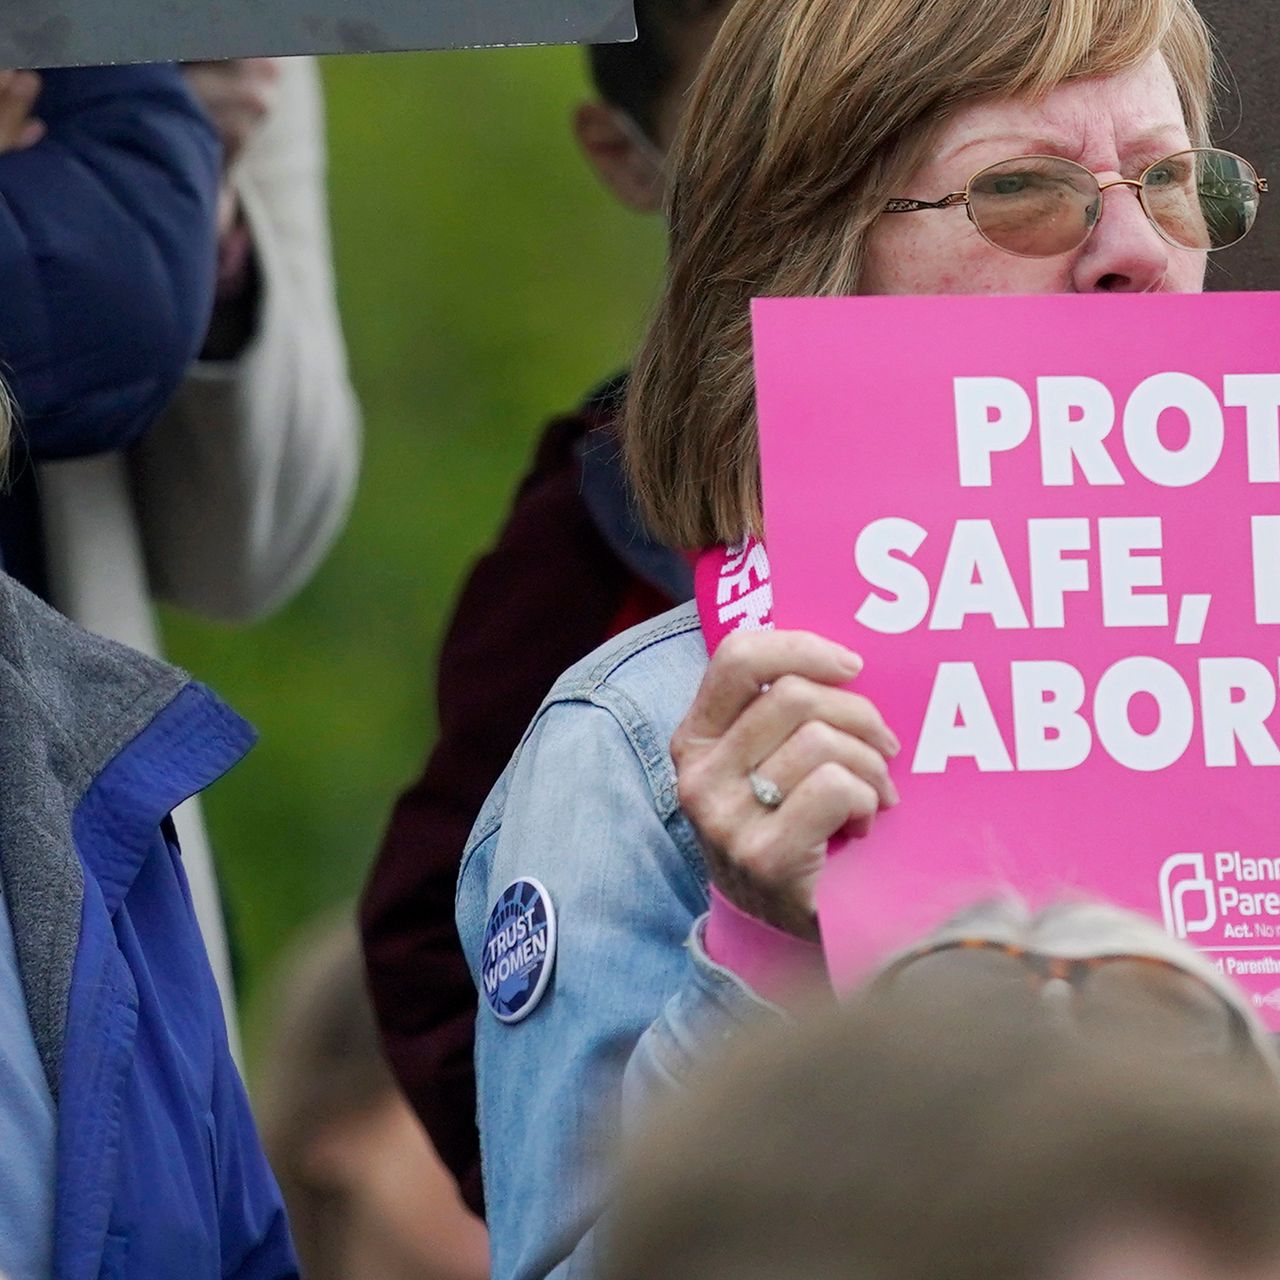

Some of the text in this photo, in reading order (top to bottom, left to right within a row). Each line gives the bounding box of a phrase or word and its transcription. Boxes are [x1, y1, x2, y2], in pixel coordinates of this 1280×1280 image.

[853, 516, 1212, 645] SAFE,
[488, 907, 535, 962] TRUST
[1224, 923, 1253, 939] Act.
[1255, 922, 1275, 938] No
[484, 929, 545, 993] WOMEN
